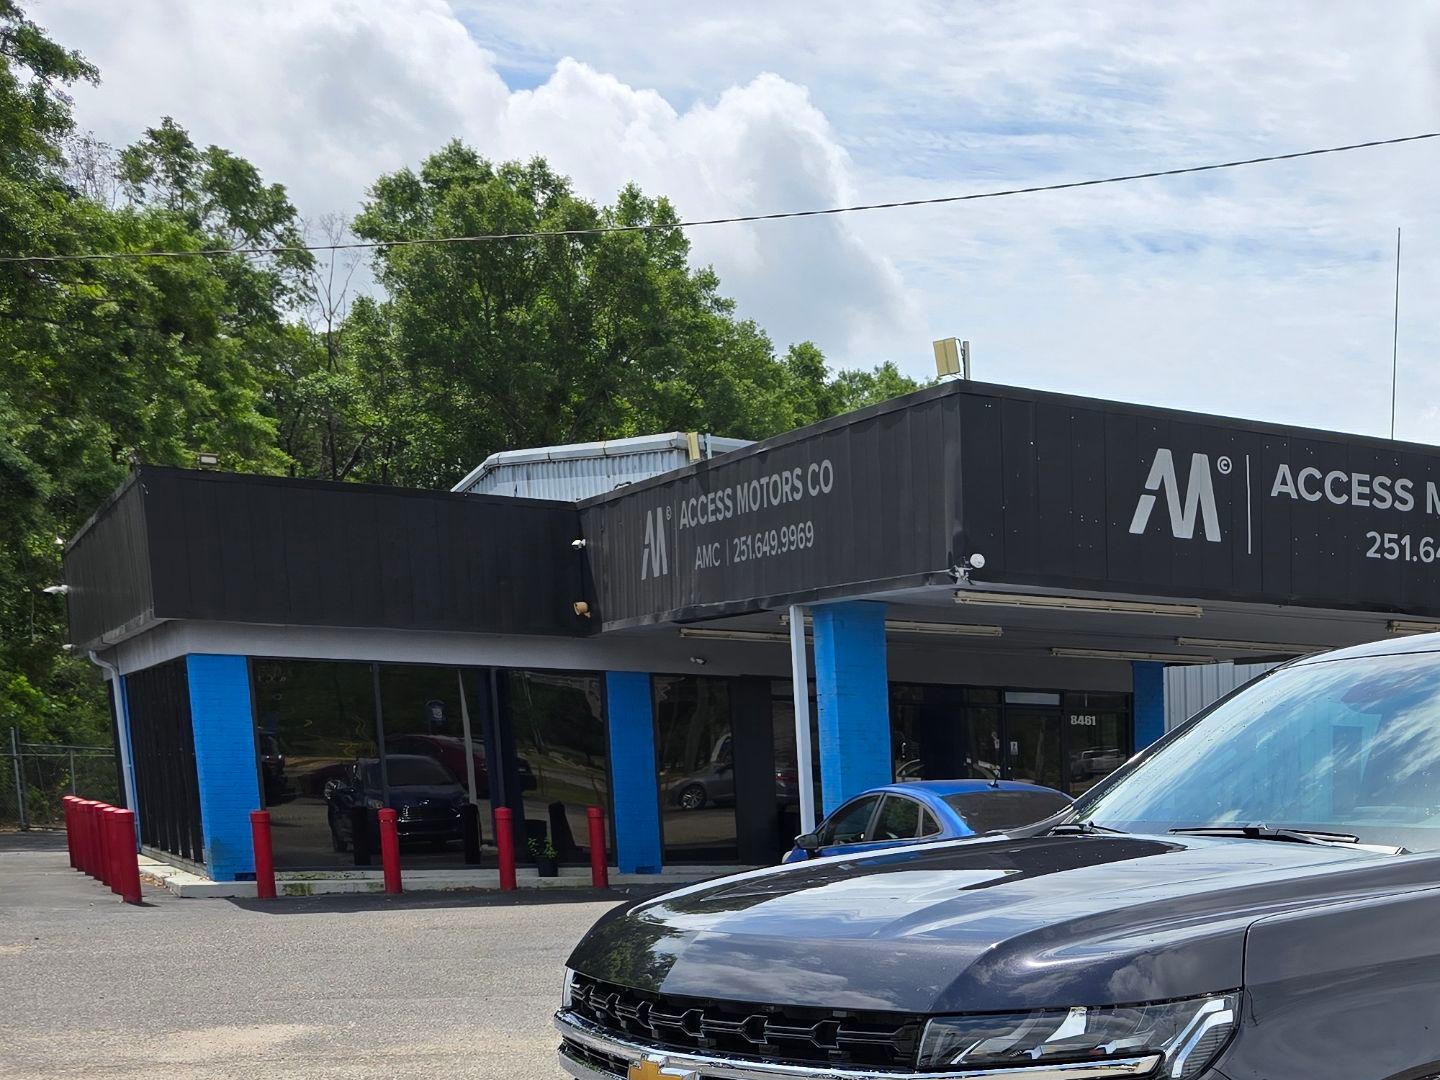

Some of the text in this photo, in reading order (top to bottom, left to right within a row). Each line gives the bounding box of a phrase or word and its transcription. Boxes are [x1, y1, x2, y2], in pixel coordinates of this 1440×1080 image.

[679, 459, 834, 530] ACCESS MOTORS CO
[1270, 463, 1415, 512] ACCESS
[694, 520, 815, 571] AMC 251.649.9969
[1070, 715, 1097, 726] 8461
